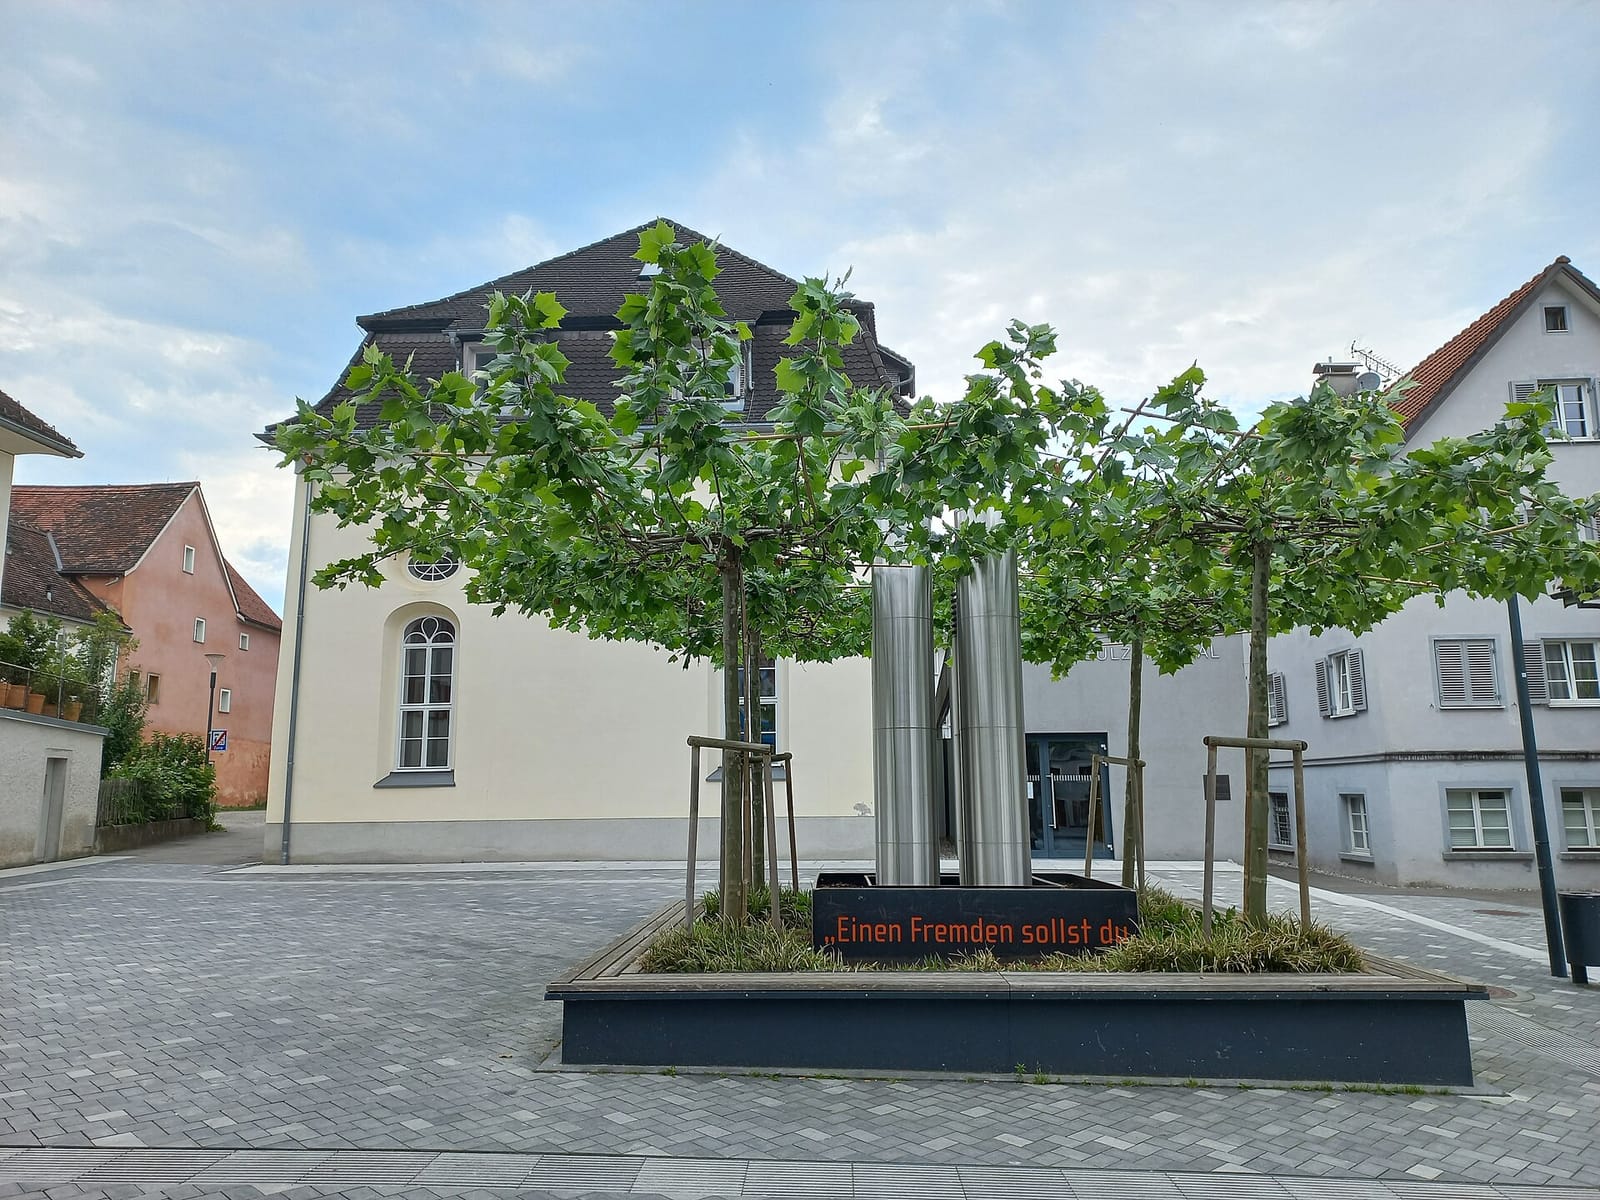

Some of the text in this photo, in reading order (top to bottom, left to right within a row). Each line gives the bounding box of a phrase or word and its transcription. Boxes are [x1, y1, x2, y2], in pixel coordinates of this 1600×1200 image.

[911, 916, 1014, 943] Fremden
[1021, 918, 1092, 944] sollst
[1099, 918, 1129, 944] du
